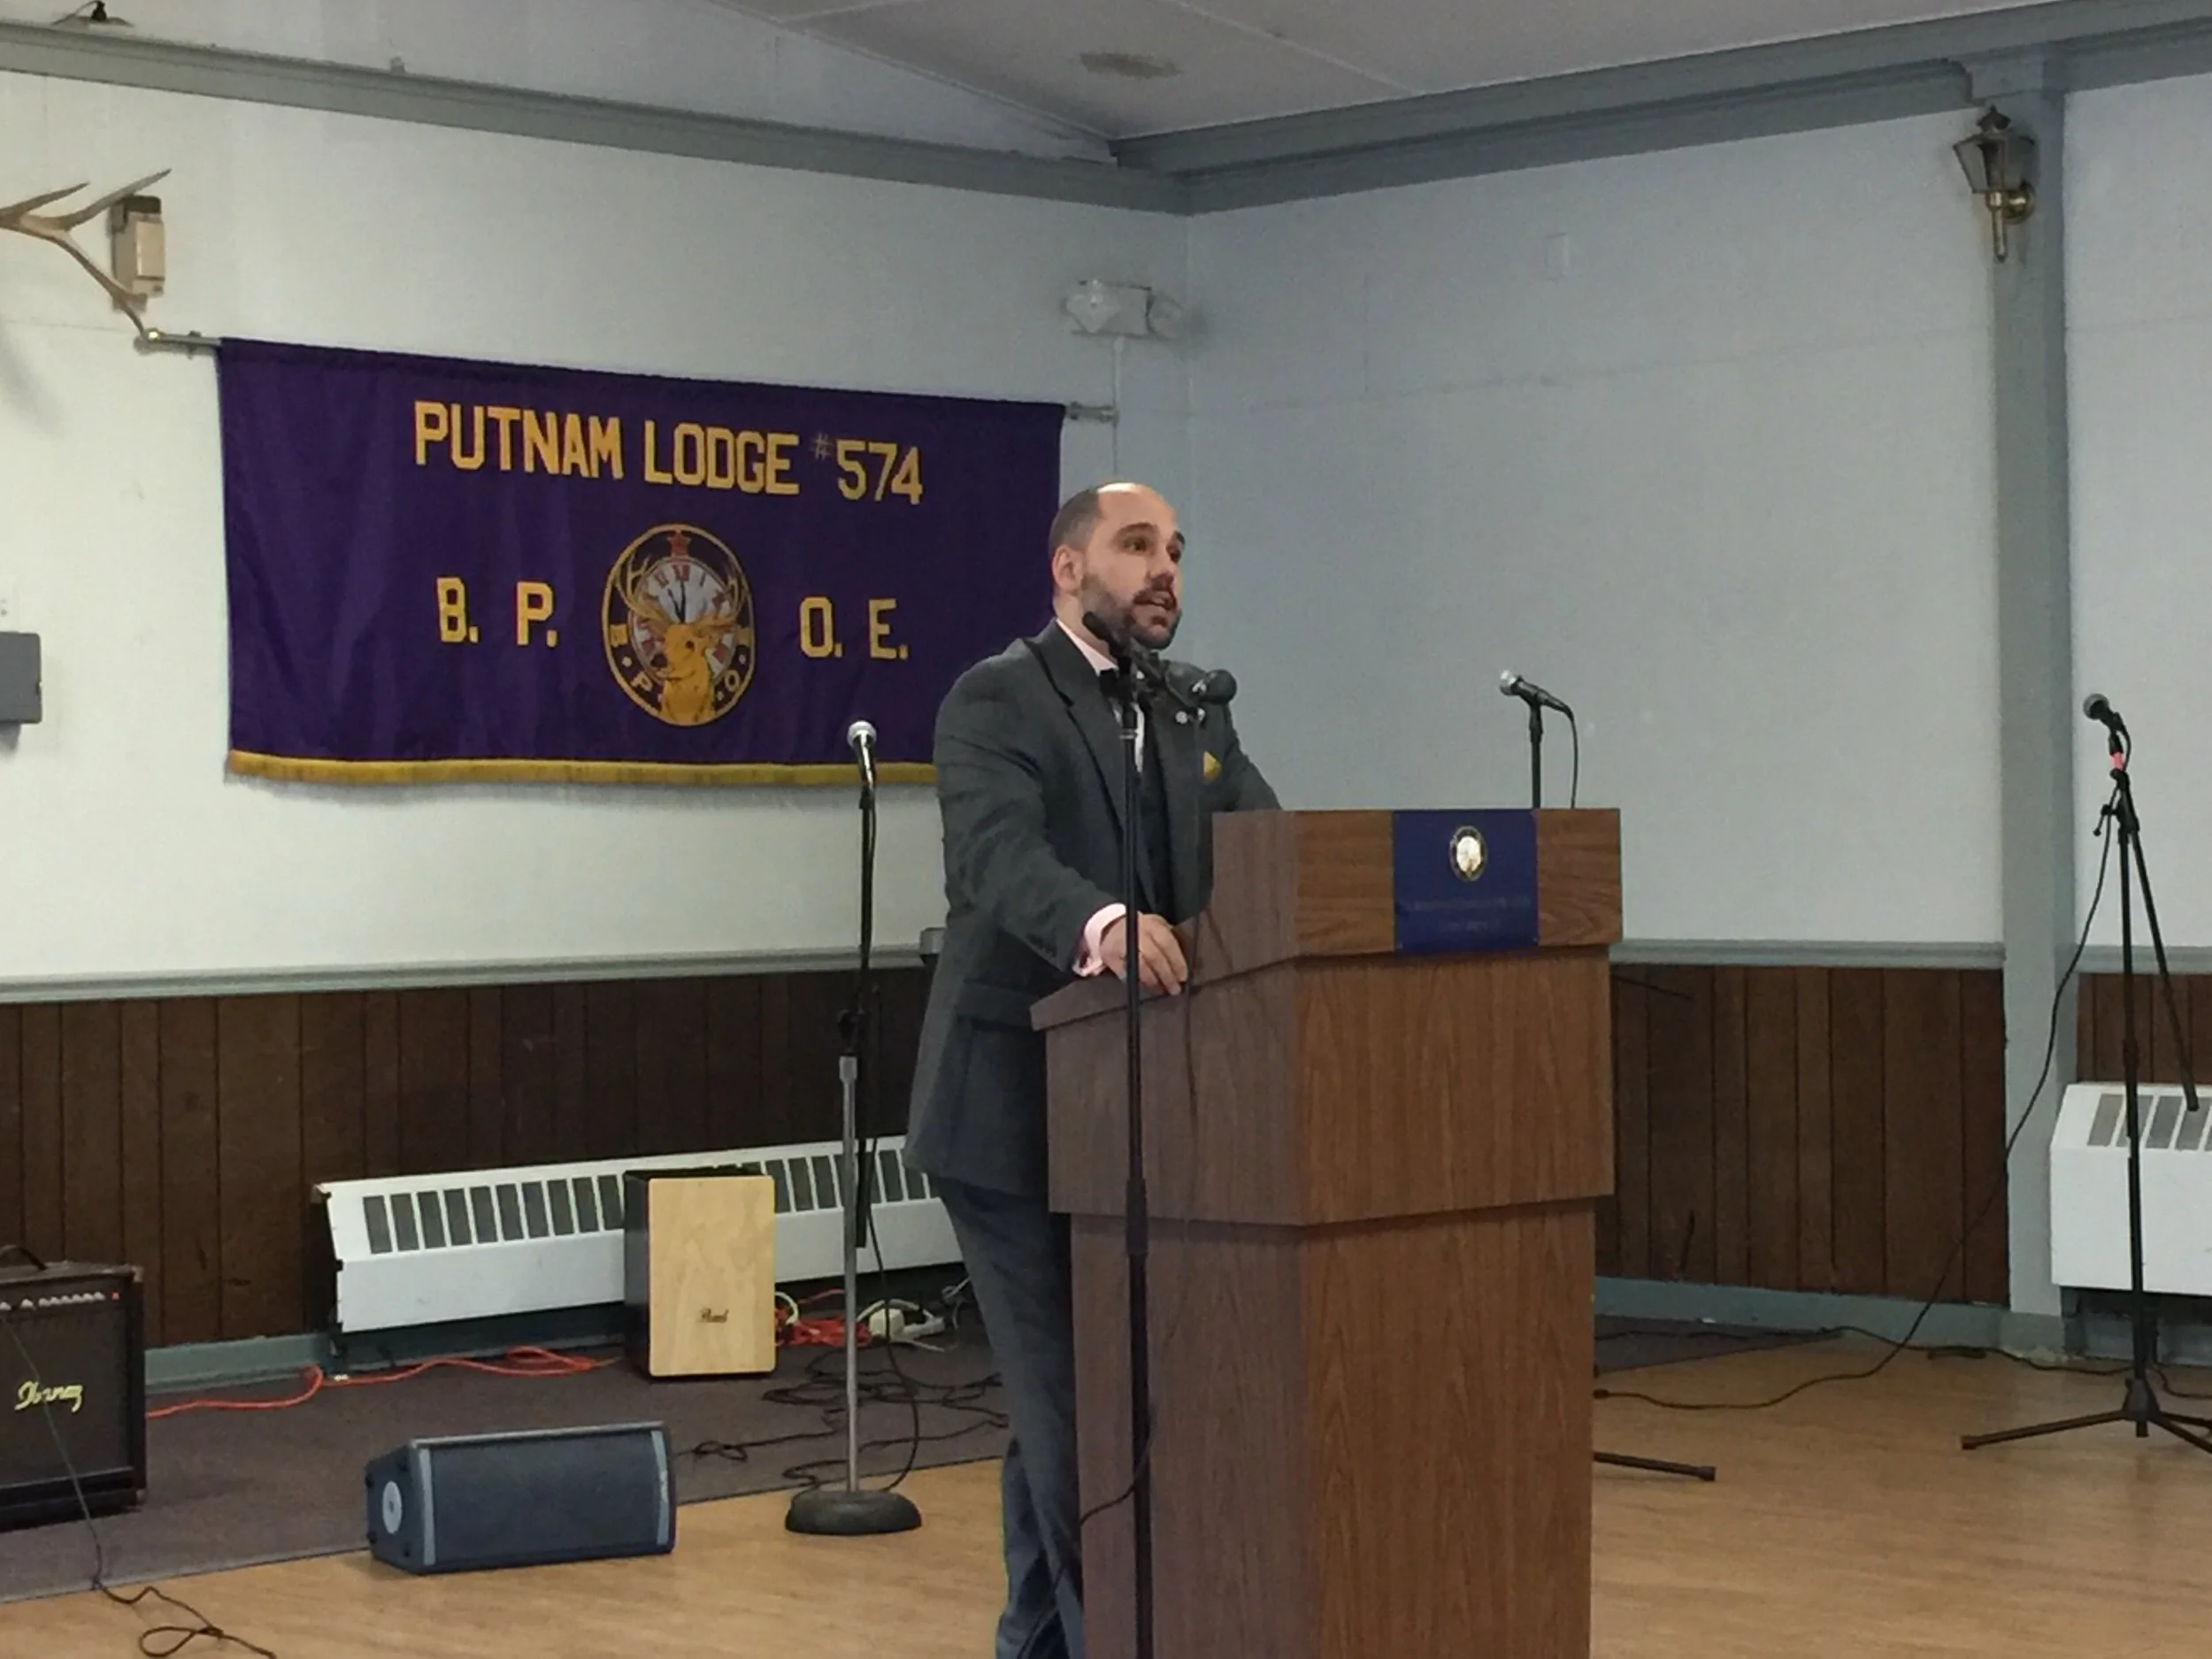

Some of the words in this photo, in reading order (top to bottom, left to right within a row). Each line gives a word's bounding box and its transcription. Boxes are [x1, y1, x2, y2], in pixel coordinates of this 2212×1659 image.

[414, 400, 624, 479] PUTNAM
[644, 420, 800, 495] LODGE
[810, 433, 924, 505] #574
[436, 577, 479, 644] B.
[516, 580, 558, 648] P.
[800, 595, 843, 658] O.
[868, 598, 910, 660] E.
